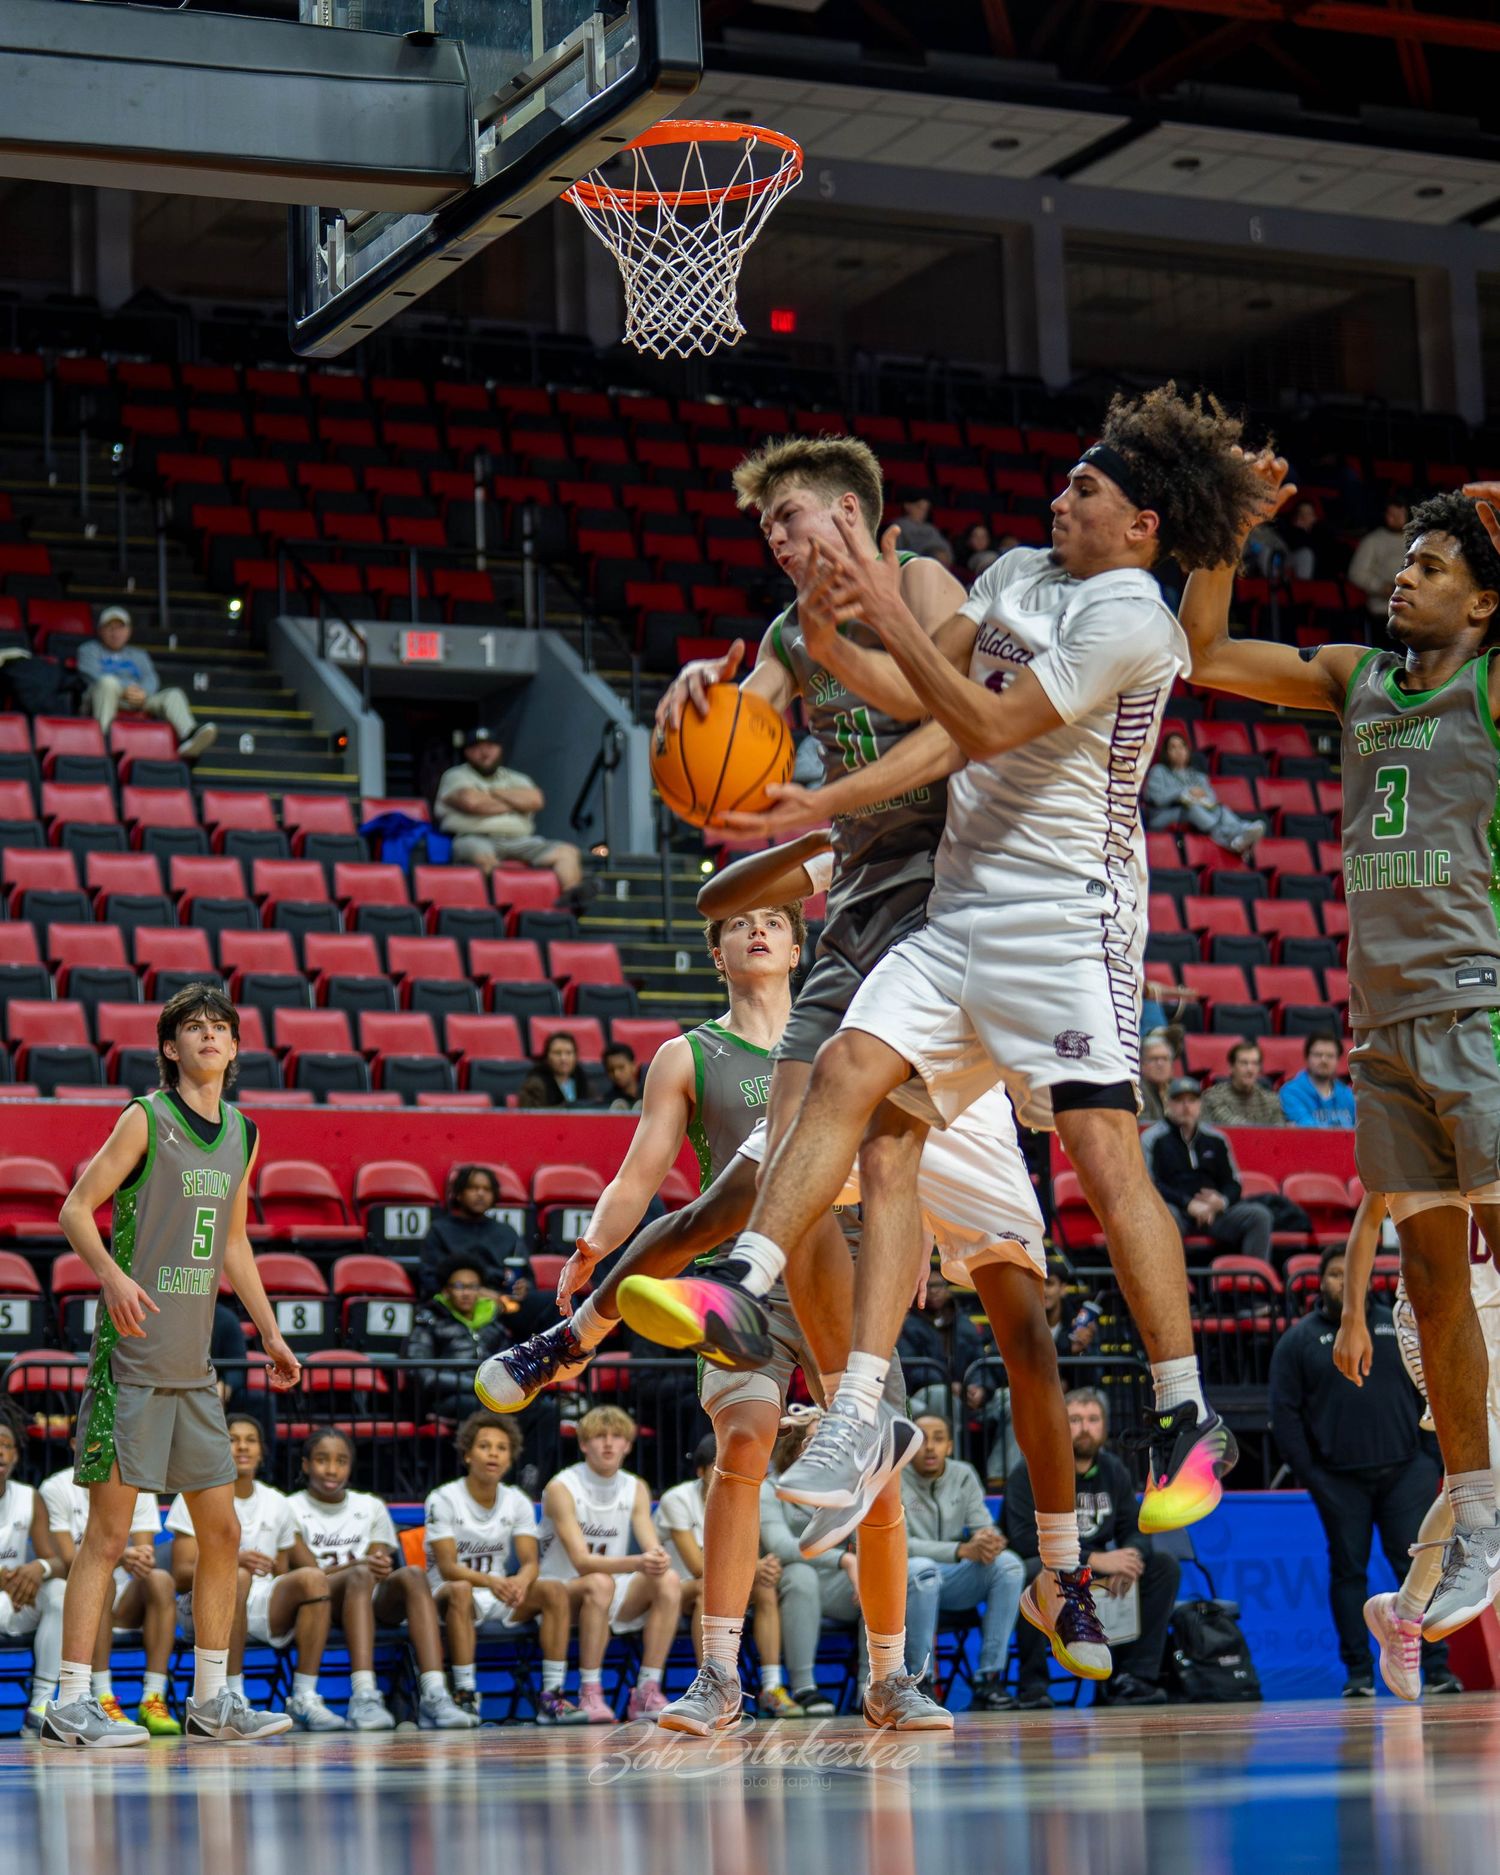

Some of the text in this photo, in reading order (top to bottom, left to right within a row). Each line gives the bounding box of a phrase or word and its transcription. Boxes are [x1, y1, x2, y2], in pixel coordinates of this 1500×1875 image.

[819, 171, 836, 198] 5
[1249, 216, 1264, 243] 6
[479, 632, 496, 667] 1
[834, 706, 880, 772] 11
[1355, 716, 1441, 756] SETON
[1372, 765, 1410, 840] 3
[1345, 850, 1451, 893] CATHOLIC
[1484, 972, 1493, 981] M
[181, 1169, 231, 1200] SETON
[191, 1207, 216, 1260] 5
[397, 1210, 419, 1235] 10
[0, 1303, 12, 1329] 5
[293, 1304, 306, 1330] 8
[383, 1305, 396, 1330] 9
[312, 1532, 362, 1547] Wildcats
[456, 1540, 504, 1553] Wildcats
